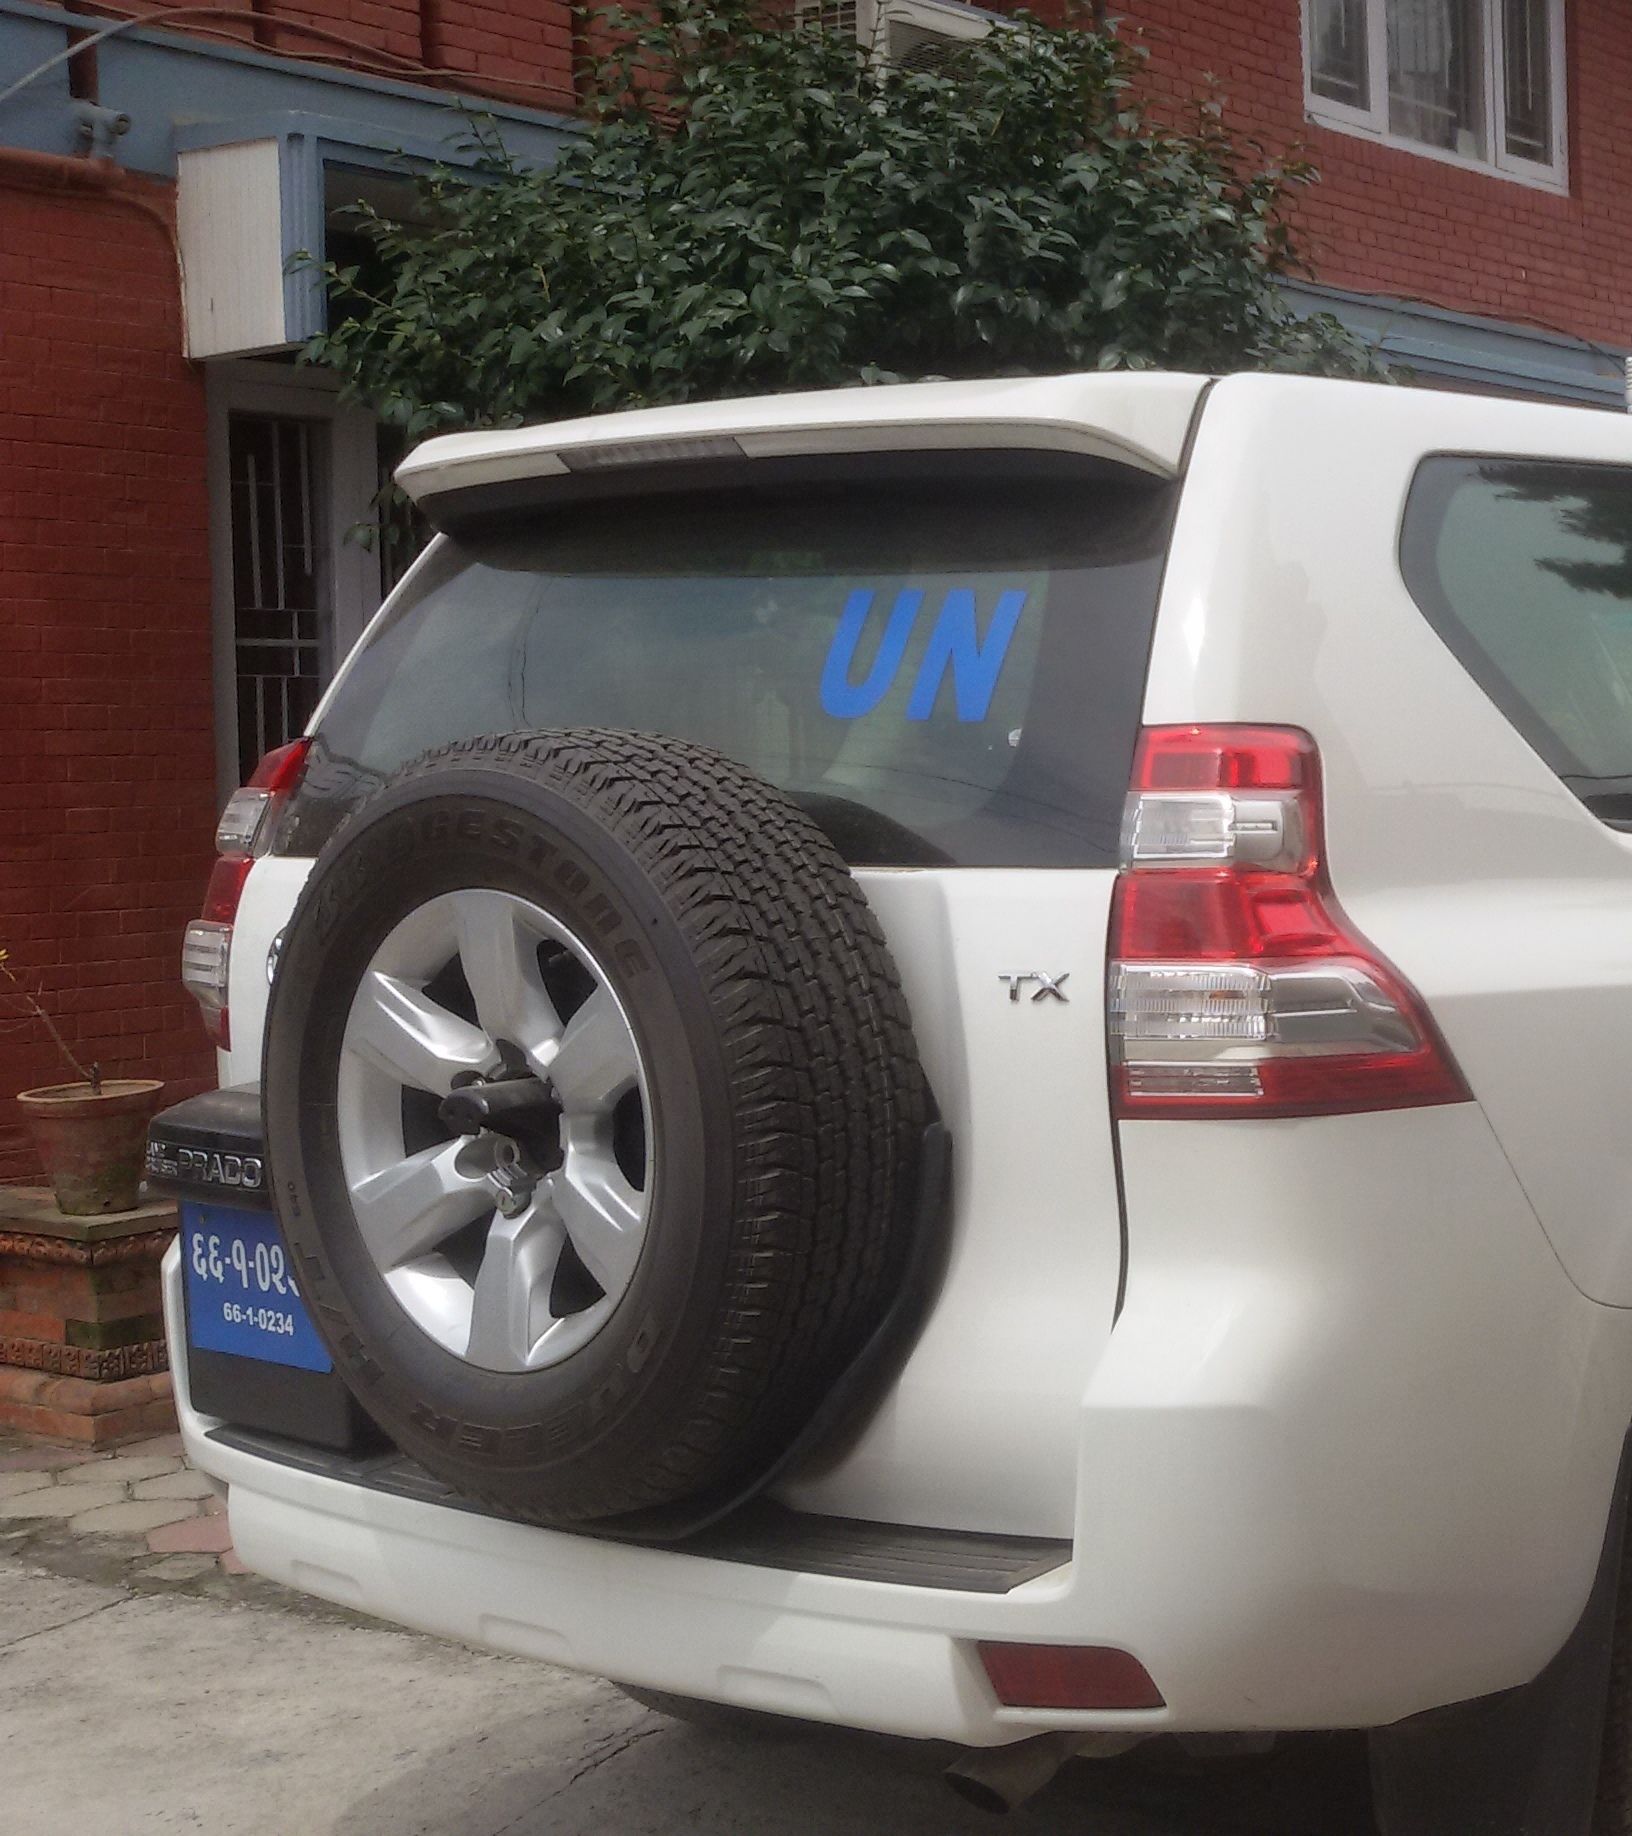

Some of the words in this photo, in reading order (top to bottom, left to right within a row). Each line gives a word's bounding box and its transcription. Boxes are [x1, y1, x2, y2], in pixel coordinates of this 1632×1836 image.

[820, 589, 1027, 722] UN
[998, 970, 1070, 1004] TX
[178, 1148, 262, 1188] PRADO
[191, 1232, 300, 1298] ६६-१-०२
[223, 1302, 294, 1336] 66-1-0234
